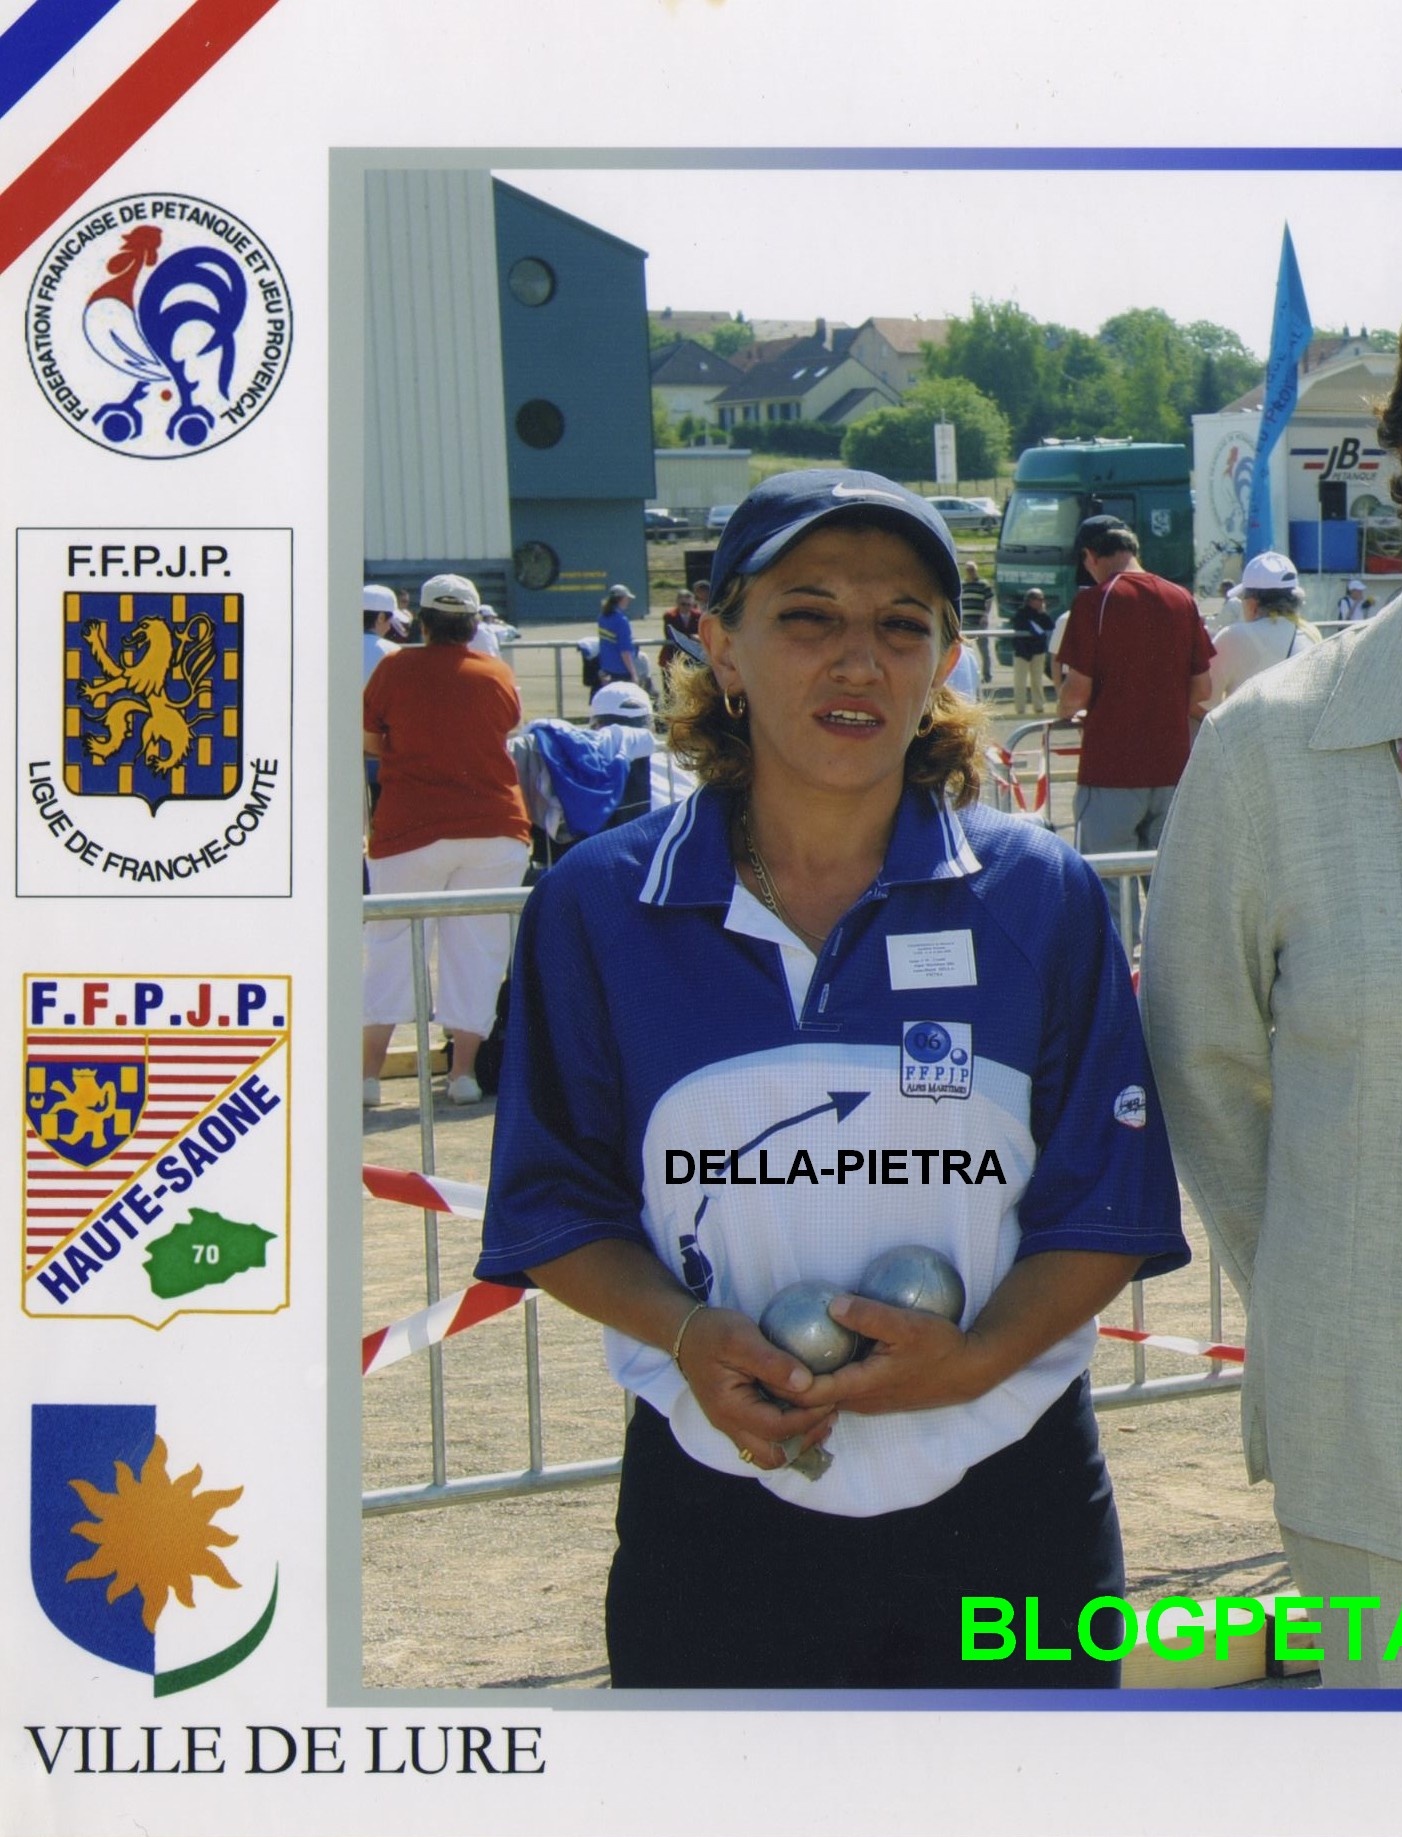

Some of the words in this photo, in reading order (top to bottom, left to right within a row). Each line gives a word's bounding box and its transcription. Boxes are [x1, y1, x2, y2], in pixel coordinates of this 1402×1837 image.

[120, 202, 148, 224] DE
[151, 201, 250, 254] PETANQUE
[41, 212, 119, 301] FRANCAISE
[244, 246, 271, 275] ET
[258, 277, 283, 314] JEU
[34, 305, 89, 422] FEDERATION
[220, 318, 285, 425] PROVENCAL
[68, 545, 231, 577] F.F.P.J.P.
[28, 761, 73, 837] LIGUE
[64, 829, 104, 866] DE
[102, 757, 279, 882] FRANCHE-COMTÉ
[31, 982, 285, 1027] F.F.P.J.P.
[914, 1032, 941, 1050] 06
[36, 1074, 282, 1305] HAUTE-SAONE
[191, 1244, 220, 1265] 70
[24, 1726, 226, 1775] VILLE
[244, 1726, 346, 1775] DE
[364, 1726, 546, 1775] LURE
